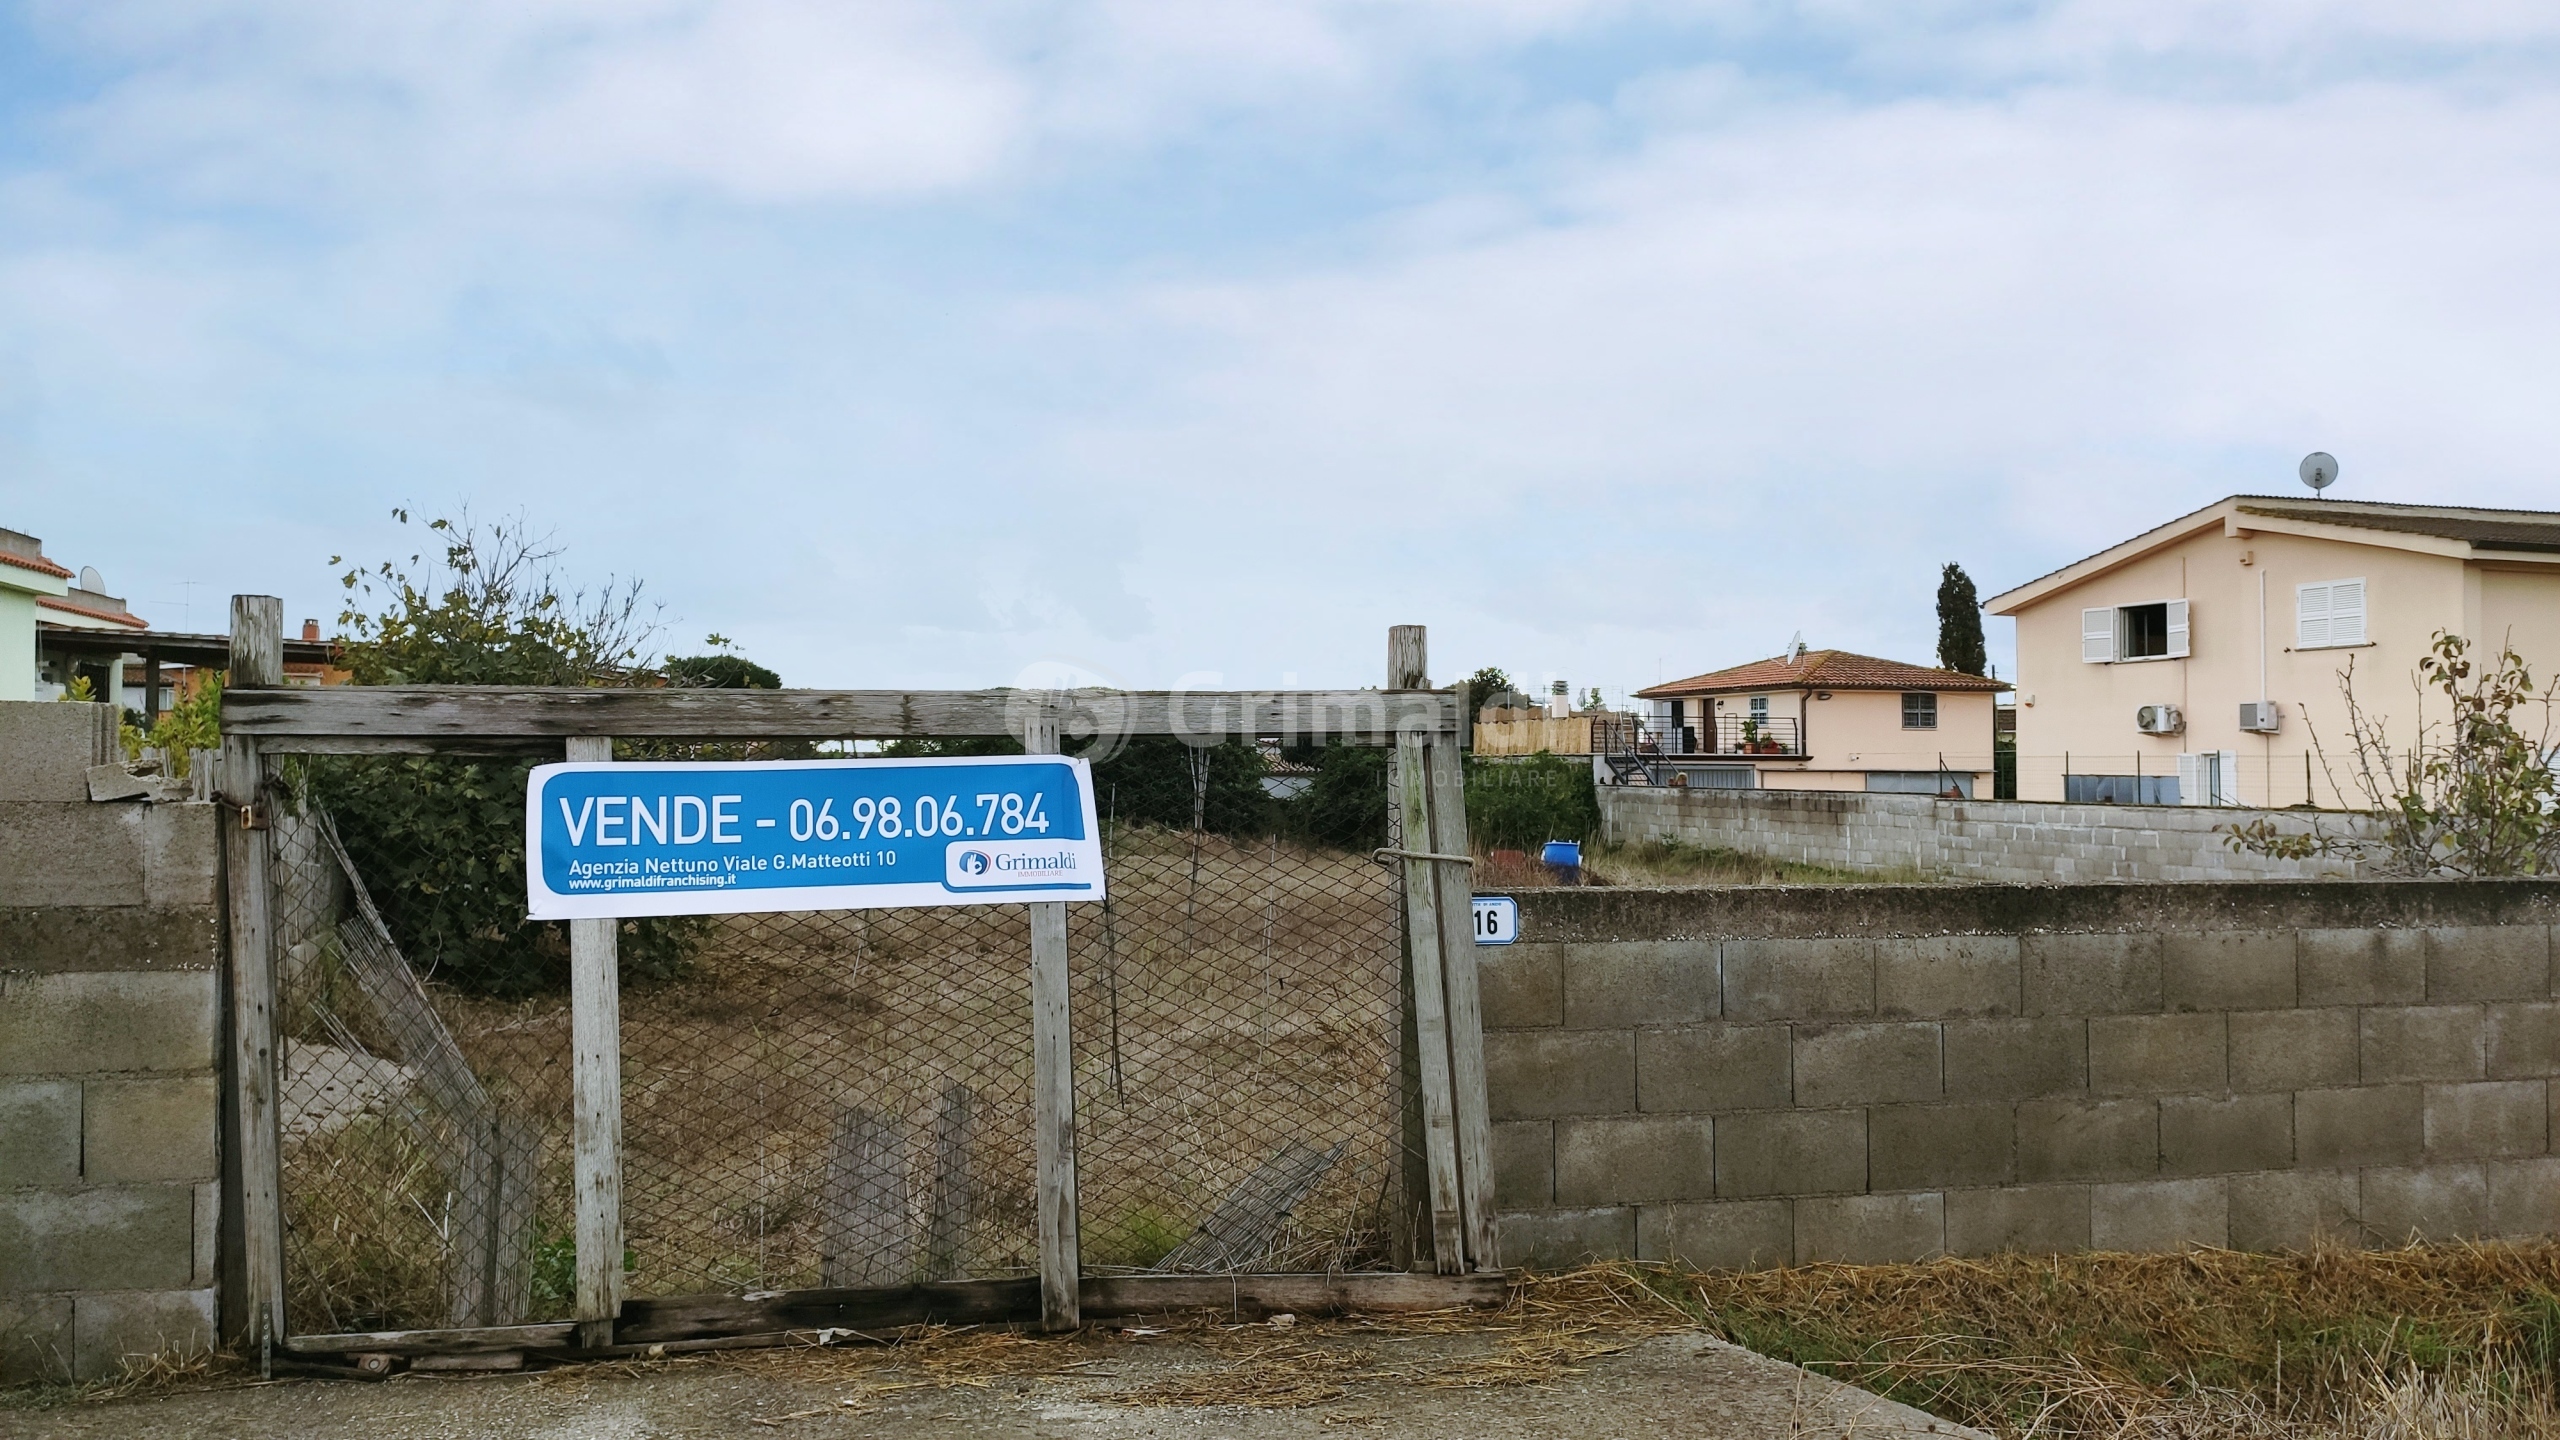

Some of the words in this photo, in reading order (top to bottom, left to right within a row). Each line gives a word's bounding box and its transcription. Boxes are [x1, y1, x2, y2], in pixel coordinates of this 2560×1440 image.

[558, 795, 742, 847] VENDE
[756, 819, 776, 828] -
[789, 792, 1050, 842] 06.98.06.784
[568, 858, 639, 879] Agenzia
[645, 857, 718, 875] Nettuno
[723, 854, 768, 871] Viale
[773, 851, 871, 870] G.Matteotti
[876, 850, 897, 866] 10
[995, 851, 1078, 872] Grimaldi
[568, 873, 737, 891] www.grimaldifranchising.it
[1017, 870, 1063, 878] IMMOBILIARE
[1474, 910, 1498, 935] 16
